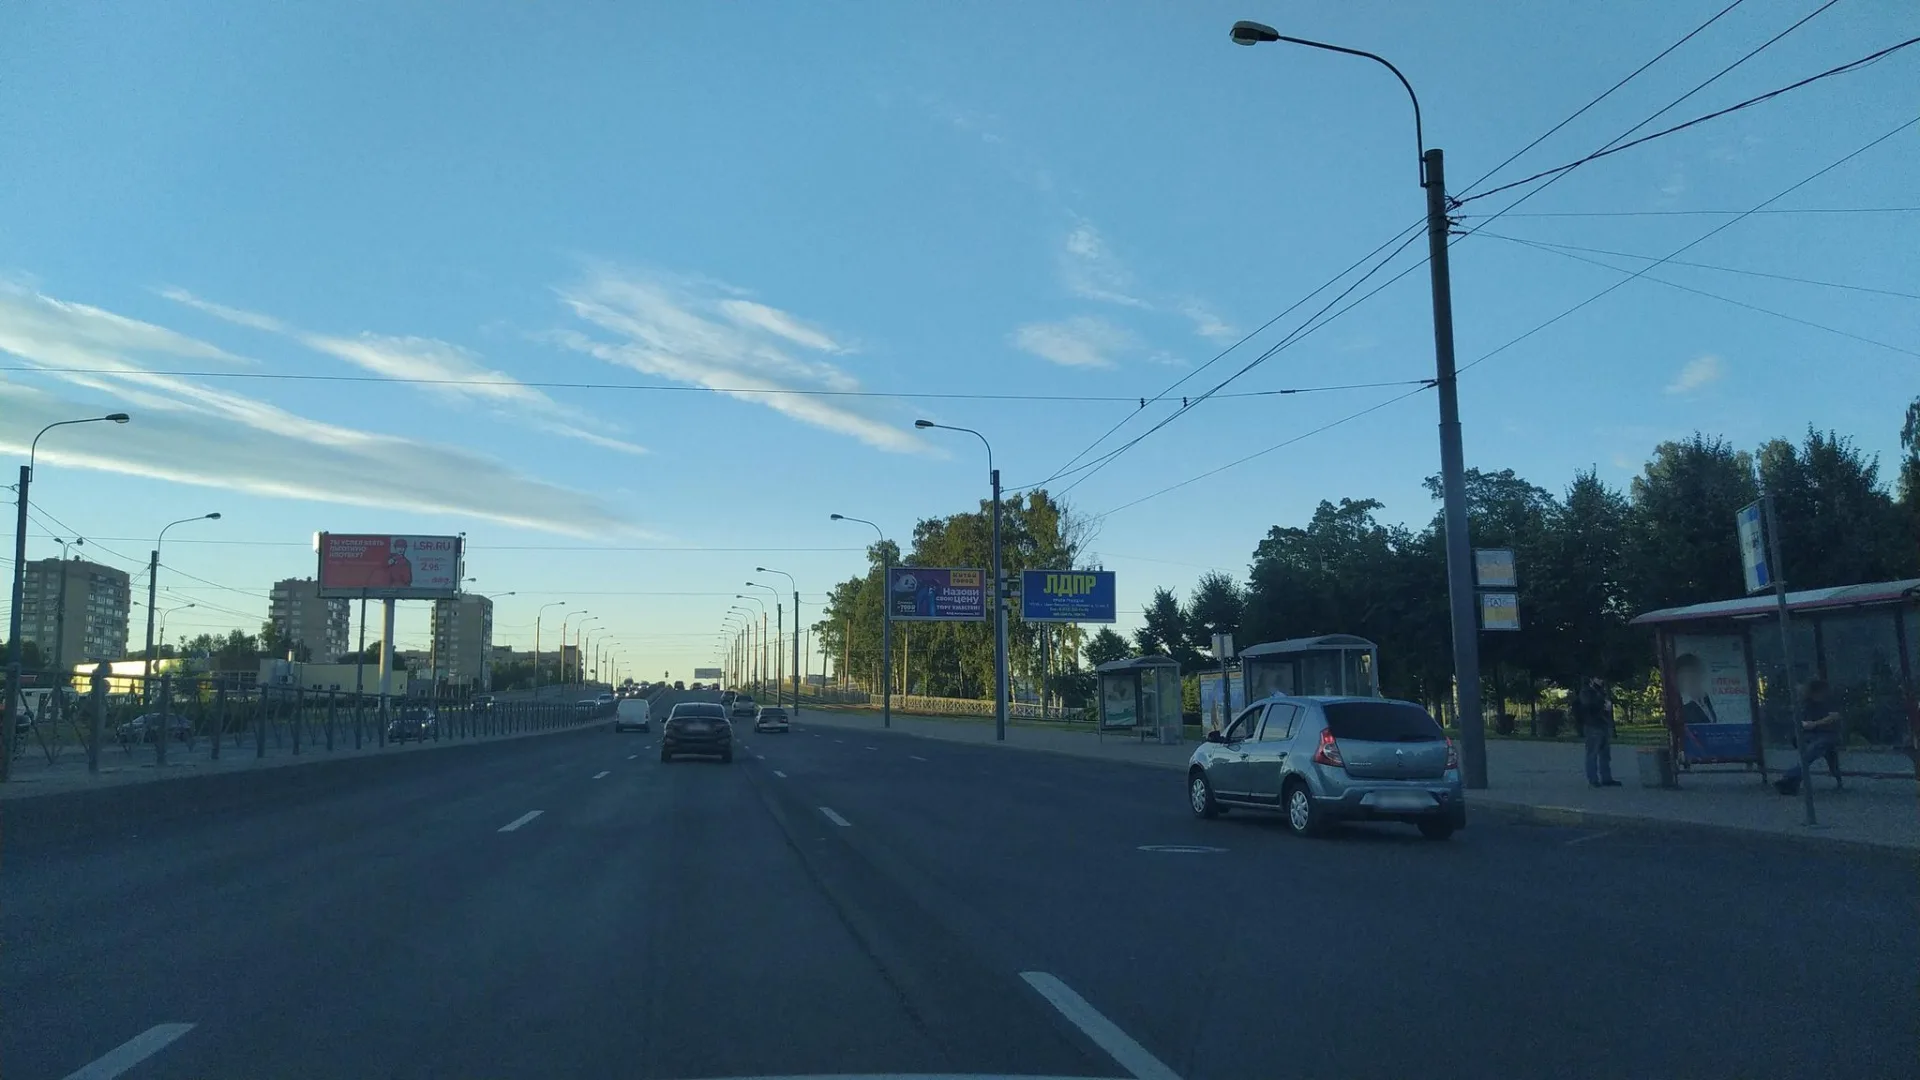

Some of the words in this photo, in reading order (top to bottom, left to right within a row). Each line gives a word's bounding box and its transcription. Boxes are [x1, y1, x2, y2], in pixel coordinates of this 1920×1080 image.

[414, 541, 450, 551] LSR.RU
[1043, 574, 1096, 597] ЛДПР
[943, 588, 980, 596] Назови
[954, 596, 980, 604] цену
